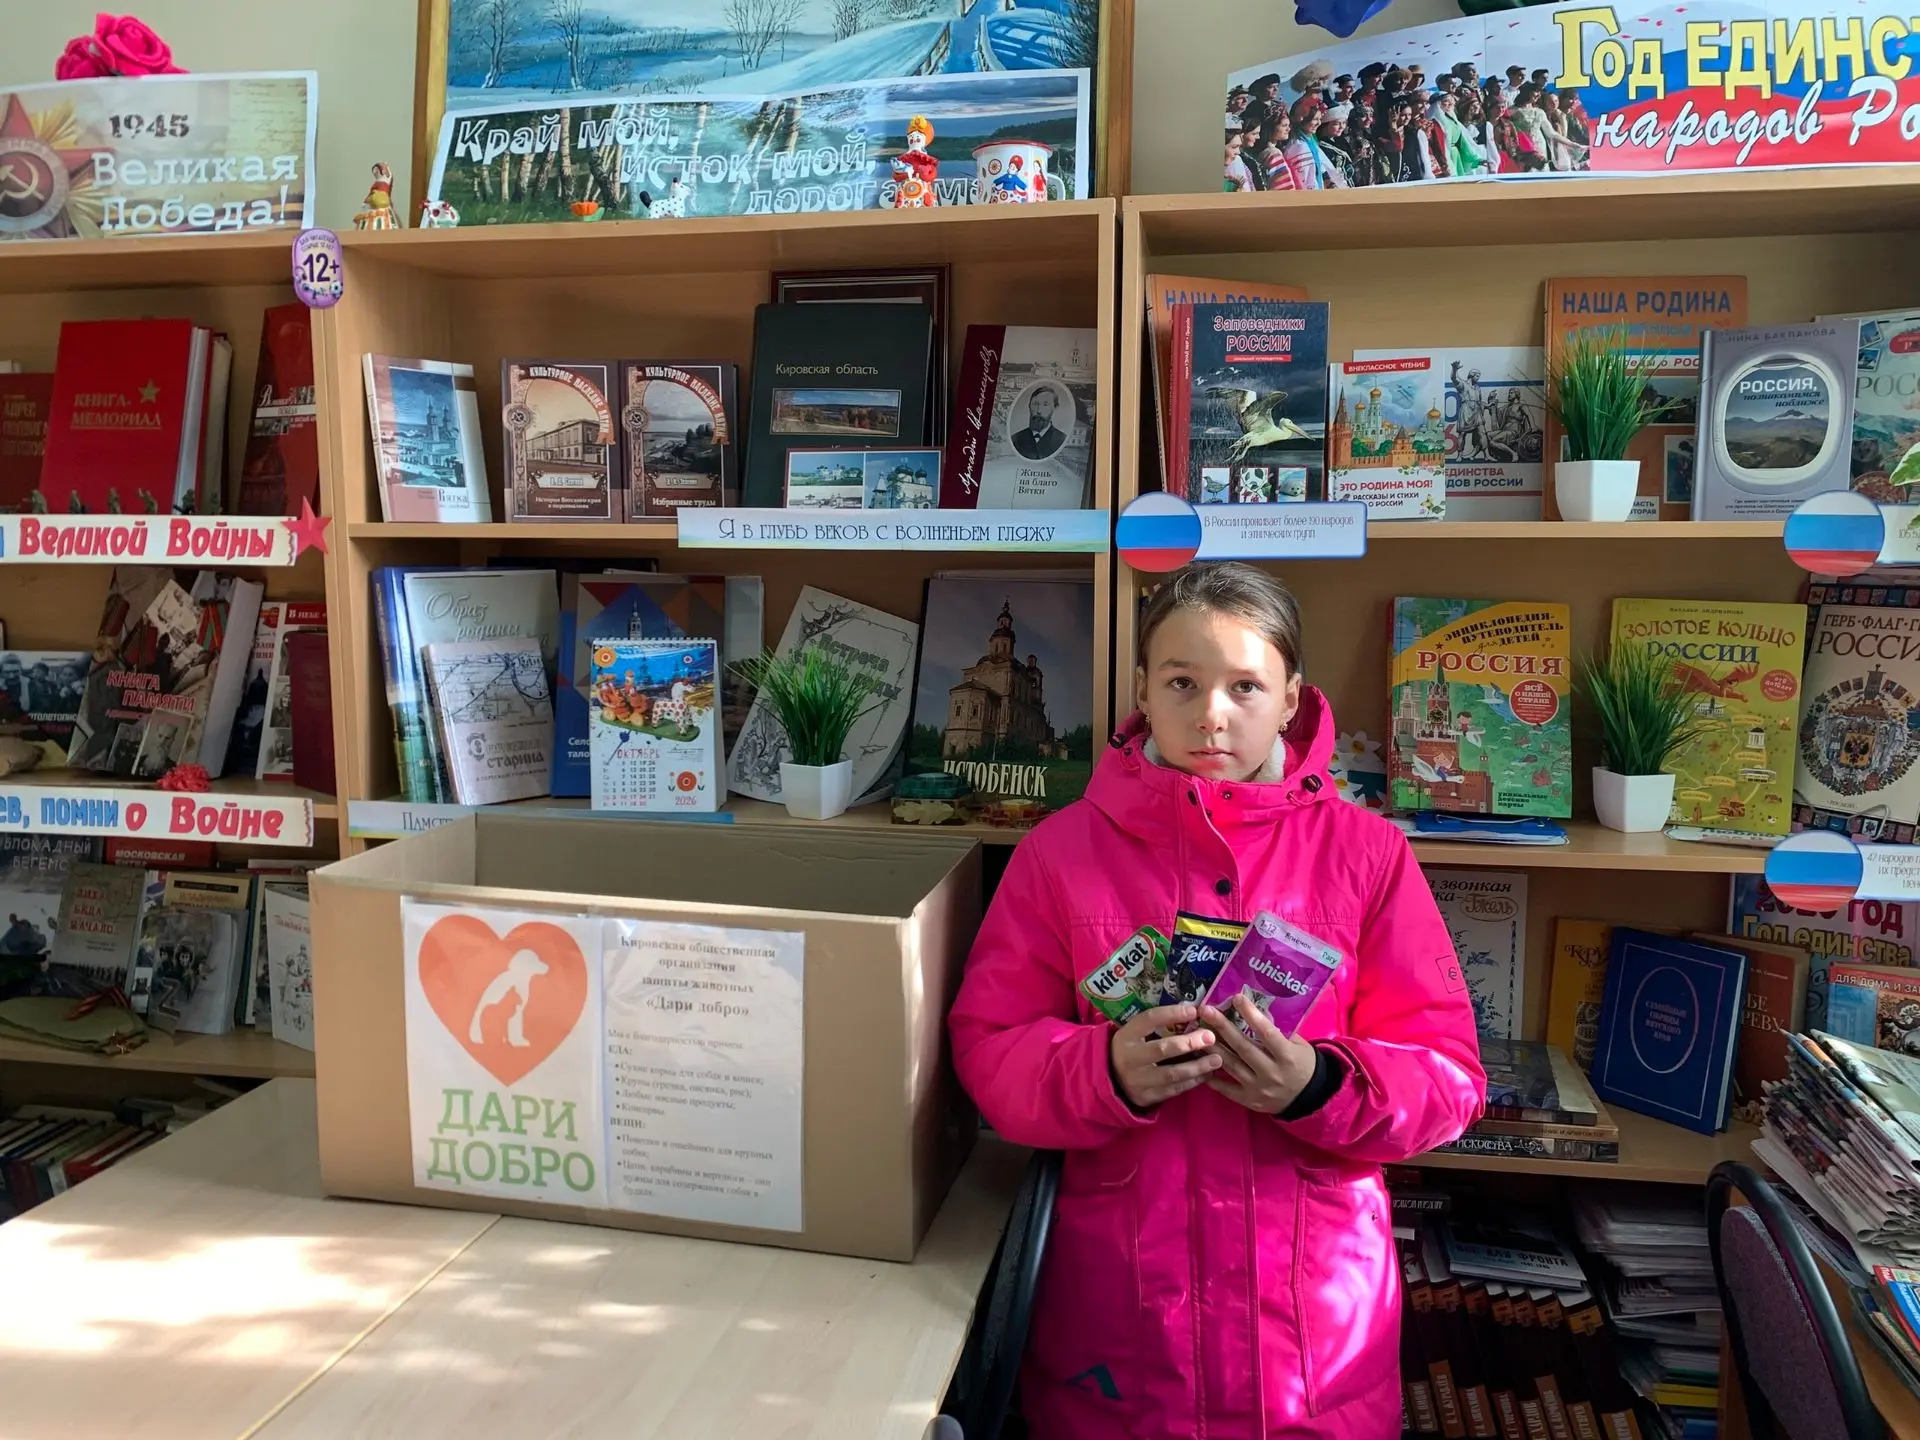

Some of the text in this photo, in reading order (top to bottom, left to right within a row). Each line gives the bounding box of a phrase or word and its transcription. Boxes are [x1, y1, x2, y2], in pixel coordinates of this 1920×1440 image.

[1553, 6, 1920, 101] Год ЕДИНС
[109, 113, 190, 139] 1945
[1594, 78, 1824, 166] народов
[454, 108, 680, 165] Край мой,
[90, 152, 299, 187] Великая
[620, 130, 876, 190] исток мой,
[100, 184, 289, 232] Победа!
[303, 253, 340, 282] 12+
[1563, 291, 1732, 317] НАША РОДИНА
[1213, 315, 1306, 333] Заповедники
[1226, 334, 1292, 352] РОССИИ
[775, 362, 879, 377] Кировская область
[1399, 360, 1426, 369] ЧТЕНИЕ
[529, 366, 573, 384] КУЛЬТУРНОЕ
[645, 366, 691, 384] КУЛЬТУРНОЕ
[1740, 377, 1818, 394] РОССИЯ,
[71, 412, 161, 427] МЕМОРИАЛ
[1020, 468, 1051, 478] Жизнь
[1032, 478, 1058, 488] благо
[1474, 478, 1523, 487] РОССИИ
[1018, 486, 1046, 495] Вятки
[1340, 479, 1434, 491] ЭТО РОДИНА МОЯ!
[1353, 493, 1389, 501] РАССКАЗЫ
[1396, 491, 1420, 499] СТИХИ
[1375, 500, 1404, 508] РОССИИ
[719, 518, 735, 540] Я
[742, 524, 754, 540] В
[814, 524, 869, 541] ВЕКОВ
[997, 525, 1056, 542] ГЛЯЖУ
[1204, 517, 1211, 527] В
[1211, 516, 1240, 527] России
[1240, 517, 1282, 530] проживает
[1283, 515, 1308, 526] более
[1321, 516, 1354, 530] народов
[19, 517, 149, 560] Великой
[166, 518, 274, 561] Войны
[1293, 528, 1316, 541] групп
[424, 590, 489, 620] Образ
[1461, 621, 1565, 645] ПУТЕВОДИТЕЛЬ
[1499, 633, 1541, 646] ДЕТЕЙ
[1623, 618, 1797, 649] ЗОЛОТОЕ КОЛЬЦО
[1647, 640, 1761, 663] РОССИИ
[1416, 650, 1565, 678] РОССИЯ
[106, 670, 160, 691] КНИГА
[1524, 683, 1544, 692] ВСЁ
[122, 690, 196, 711] ПАМЯТИ
[1521, 691, 1552, 699] НАШЕЙ
[616, 748, 661, 760] ОКТЯБРЬ
[943, 759, 1049, 798] ИСТОБЕНСК
[40, 796, 284, 841] помни о Войне
[4, 836, 91, 855] БЛОКАДНЫЙ
[115, 850, 186, 861] МОСКОВСКАЯ
[1440, 879, 1513, 893] звонкая
[1848, 899, 1904, 939] ГОД
[1210, 928, 1241, 940] КУРИЦА
[621, 935, 776, 959] Кировская общественная
[1177, 943, 1218, 966] felix
[1794, 926, 1914, 968] единства
[1092, 941, 1149, 995] kitekat
[1248, 955, 1311, 997] whiskas
[1835, 973, 1900, 991] ДЛЯ ДОМА И
[646, 994, 750, 1018] «Дари добро»
[608, 1045, 633, 1056] ЕДА:
[436, 1087, 579, 1142] ДАРИ
[609, 1116, 646, 1129] ВЕЩИ:
[426, 1136, 595, 1193] ДОБРО
[1517, 1251, 1569, 1268] ФРОНТА
